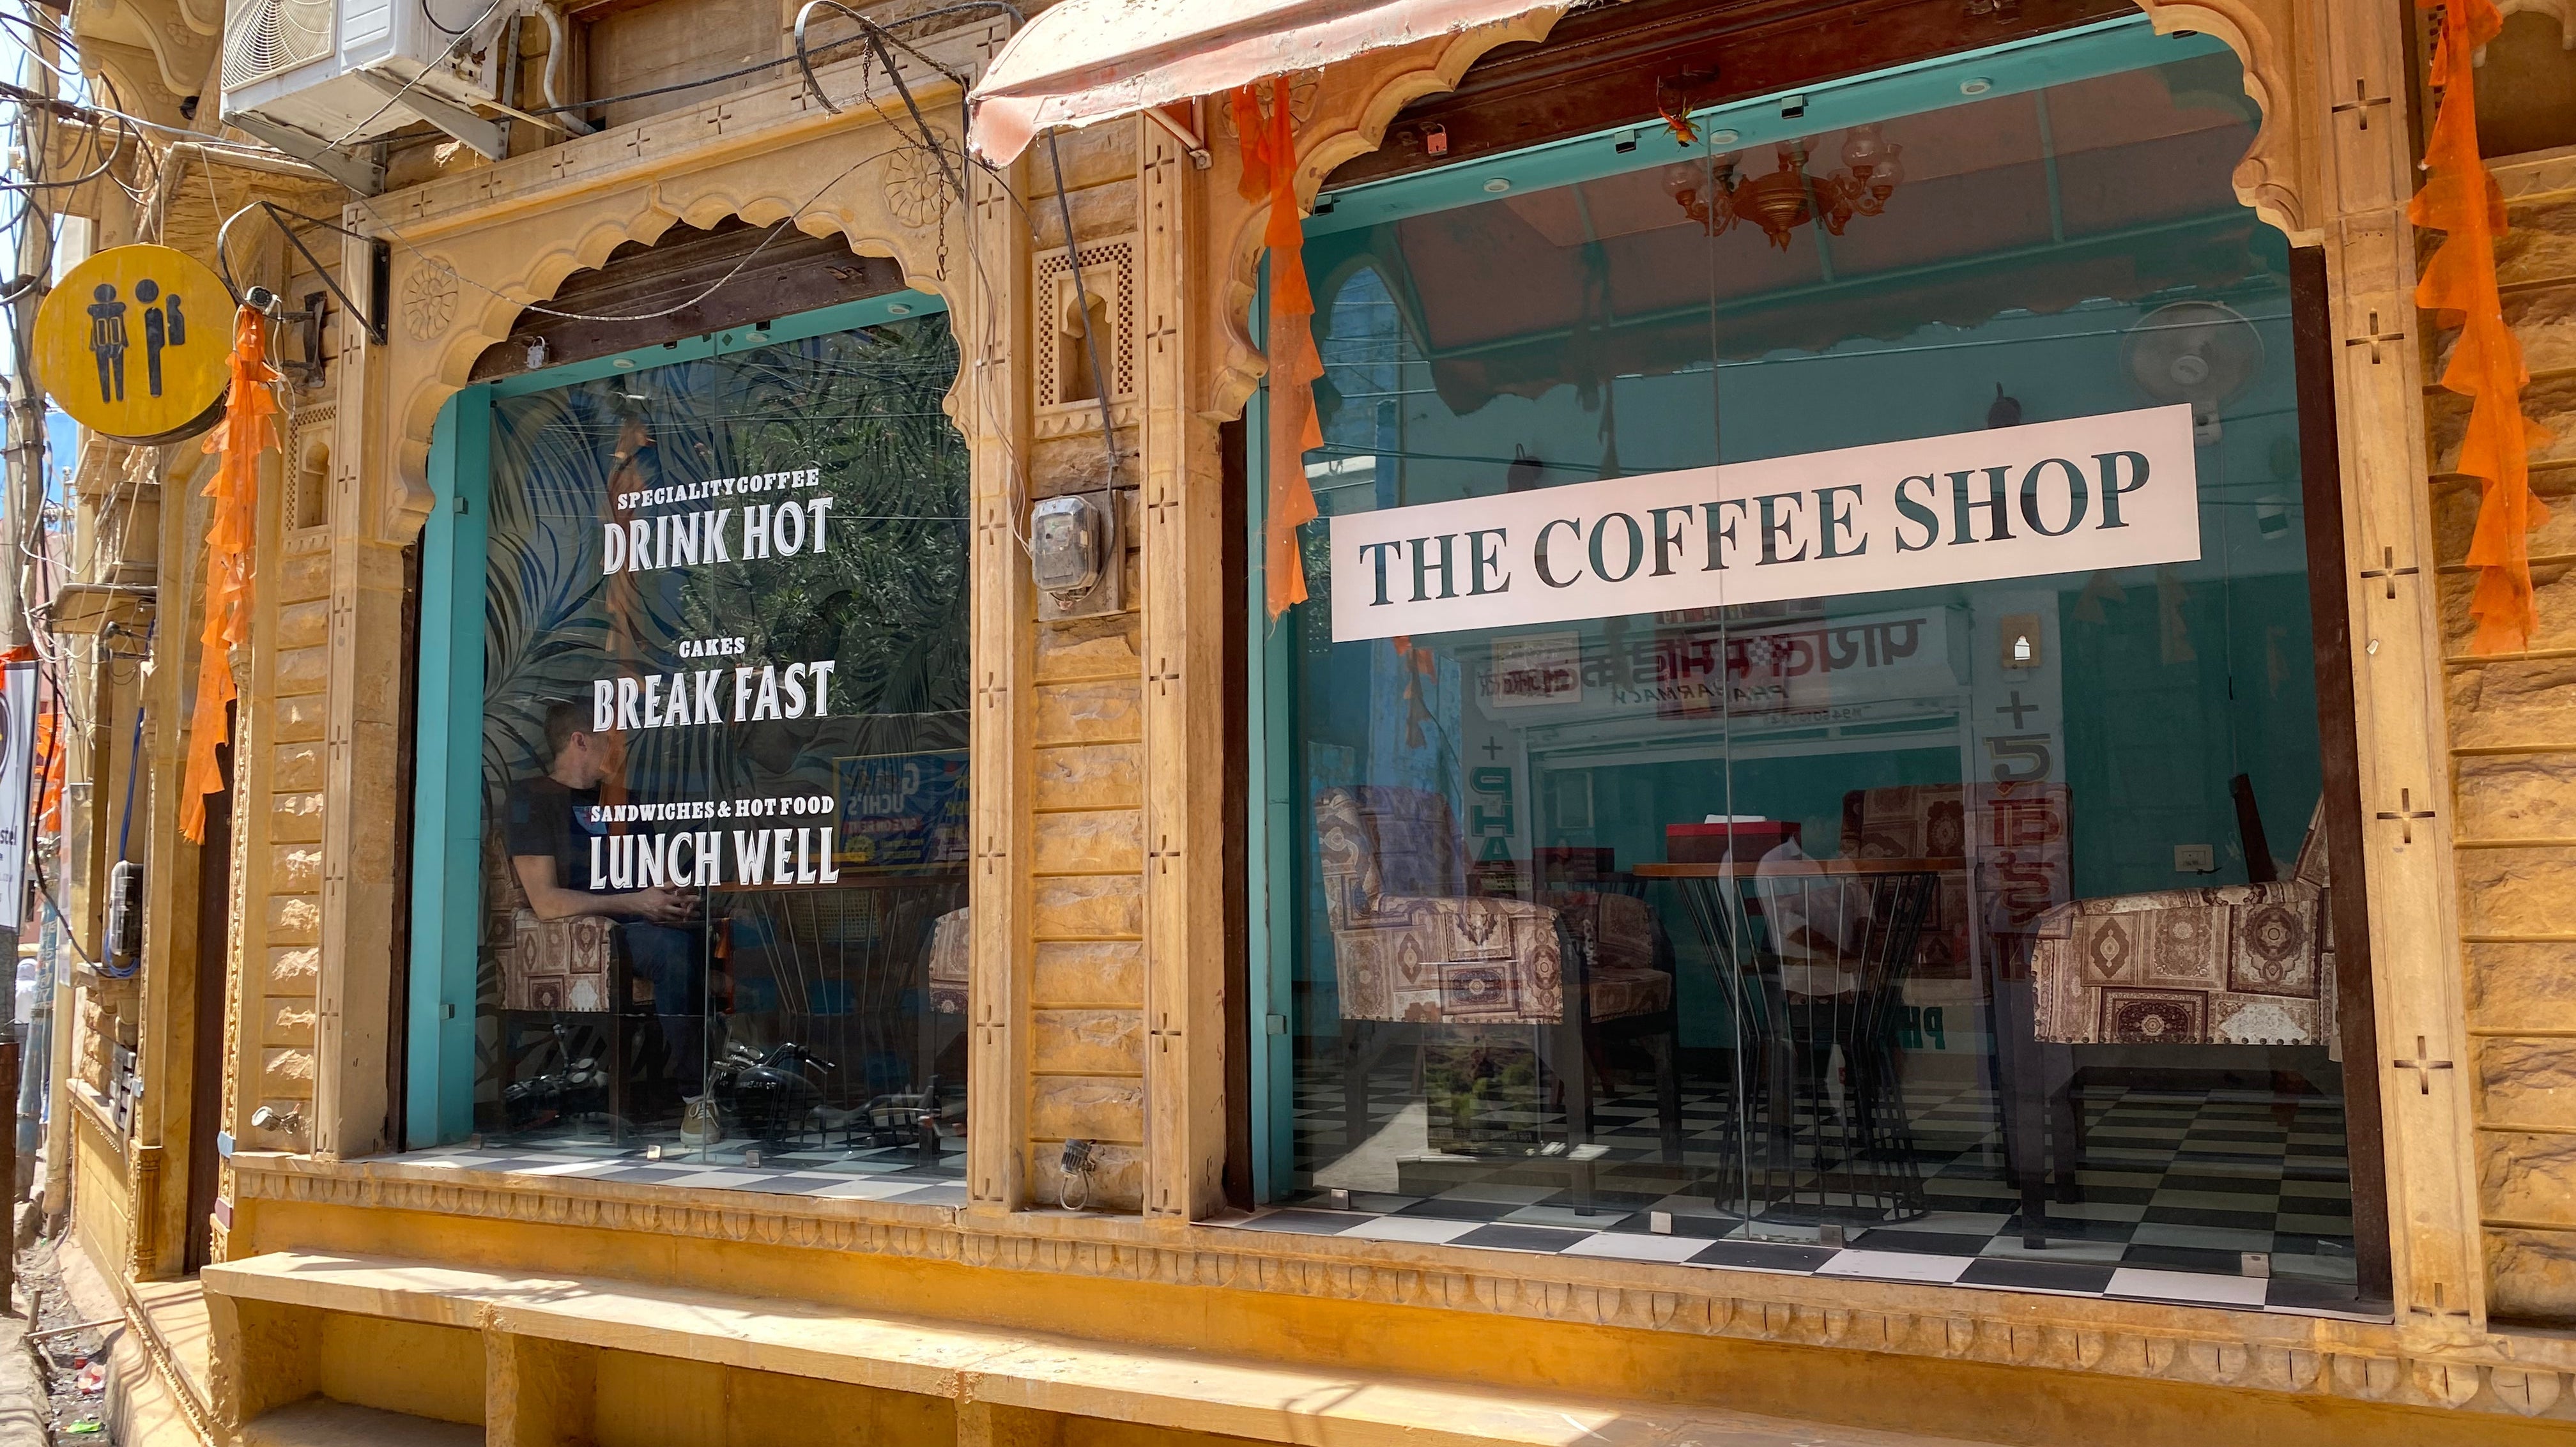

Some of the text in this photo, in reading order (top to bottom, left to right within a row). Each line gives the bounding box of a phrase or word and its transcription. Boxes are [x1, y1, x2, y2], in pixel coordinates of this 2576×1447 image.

[603, 497, 833, 575] DRINK HOT
[1360, 450, 2149, 607] THE COFFEE SHOP
[678, 637, 746, 658] CAKES
[592, 660, 835, 732] BREAK FAST
[591, 796, 834, 822] SANDWICHES & HOT FOOD
[589, 831, 722, 889] LUNCH
[733, 827, 839, 885] WELL
